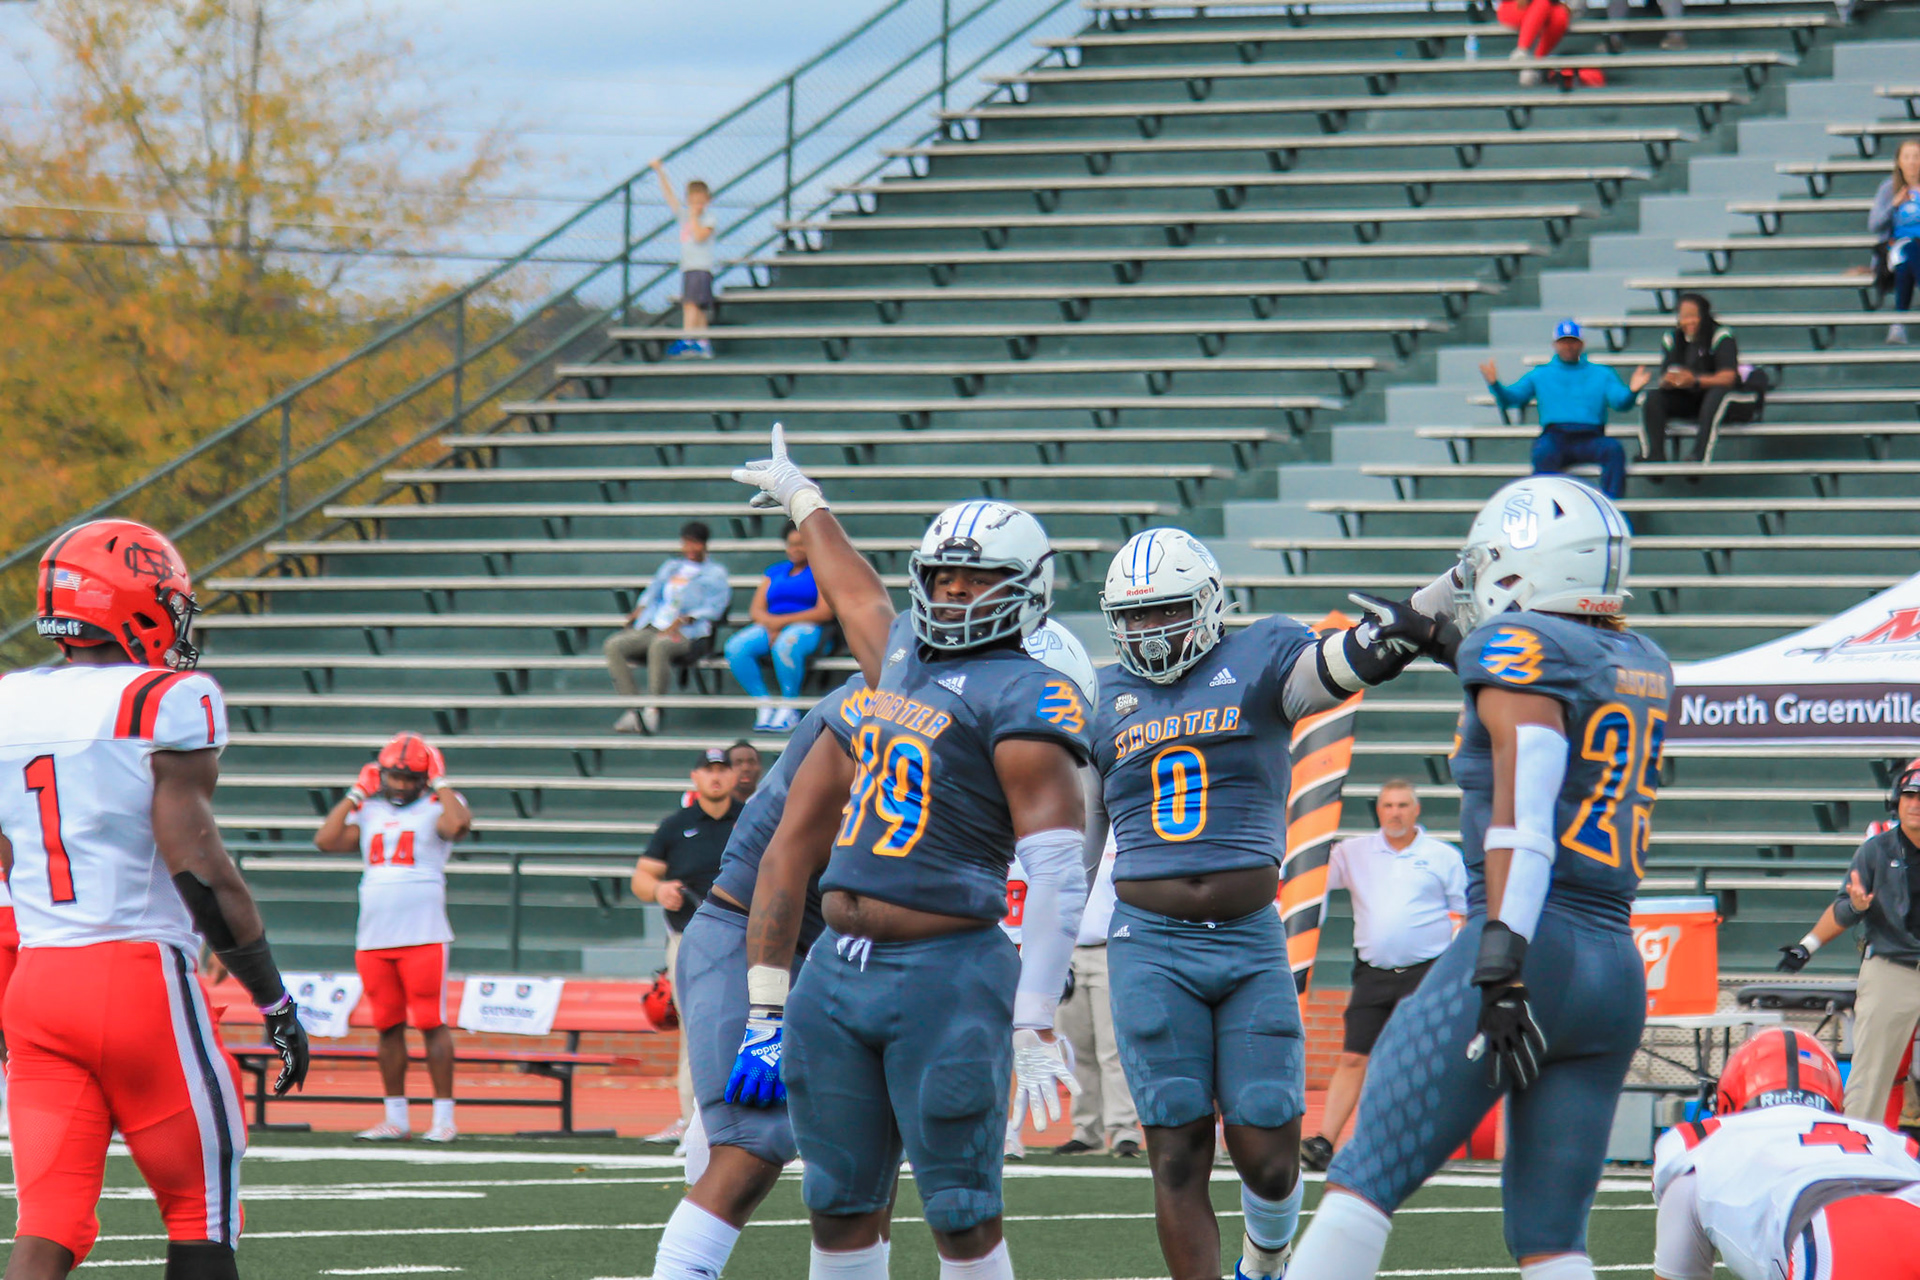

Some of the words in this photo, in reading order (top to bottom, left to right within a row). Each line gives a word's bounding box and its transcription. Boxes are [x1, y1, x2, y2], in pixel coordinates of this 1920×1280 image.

[1126, 586, 1154, 596] Riddell
[1577, 598, 1622, 613] Ridde
[937, 680, 963, 696] adidas
[1209, 677, 1237, 687] adidas
[199, 694, 215, 744] 1
[1679, 694, 1769, 726] North
[1115, 706, 1241, 760] SHORTER
[1151, 745, 1209, 842] 0
[23, 753, 78, 905] 1
[369, 830, 416, 866] 44
[1760, 1090, 1826, 1111] Riddell
[1798, 1121, 1873, 1155] 4
